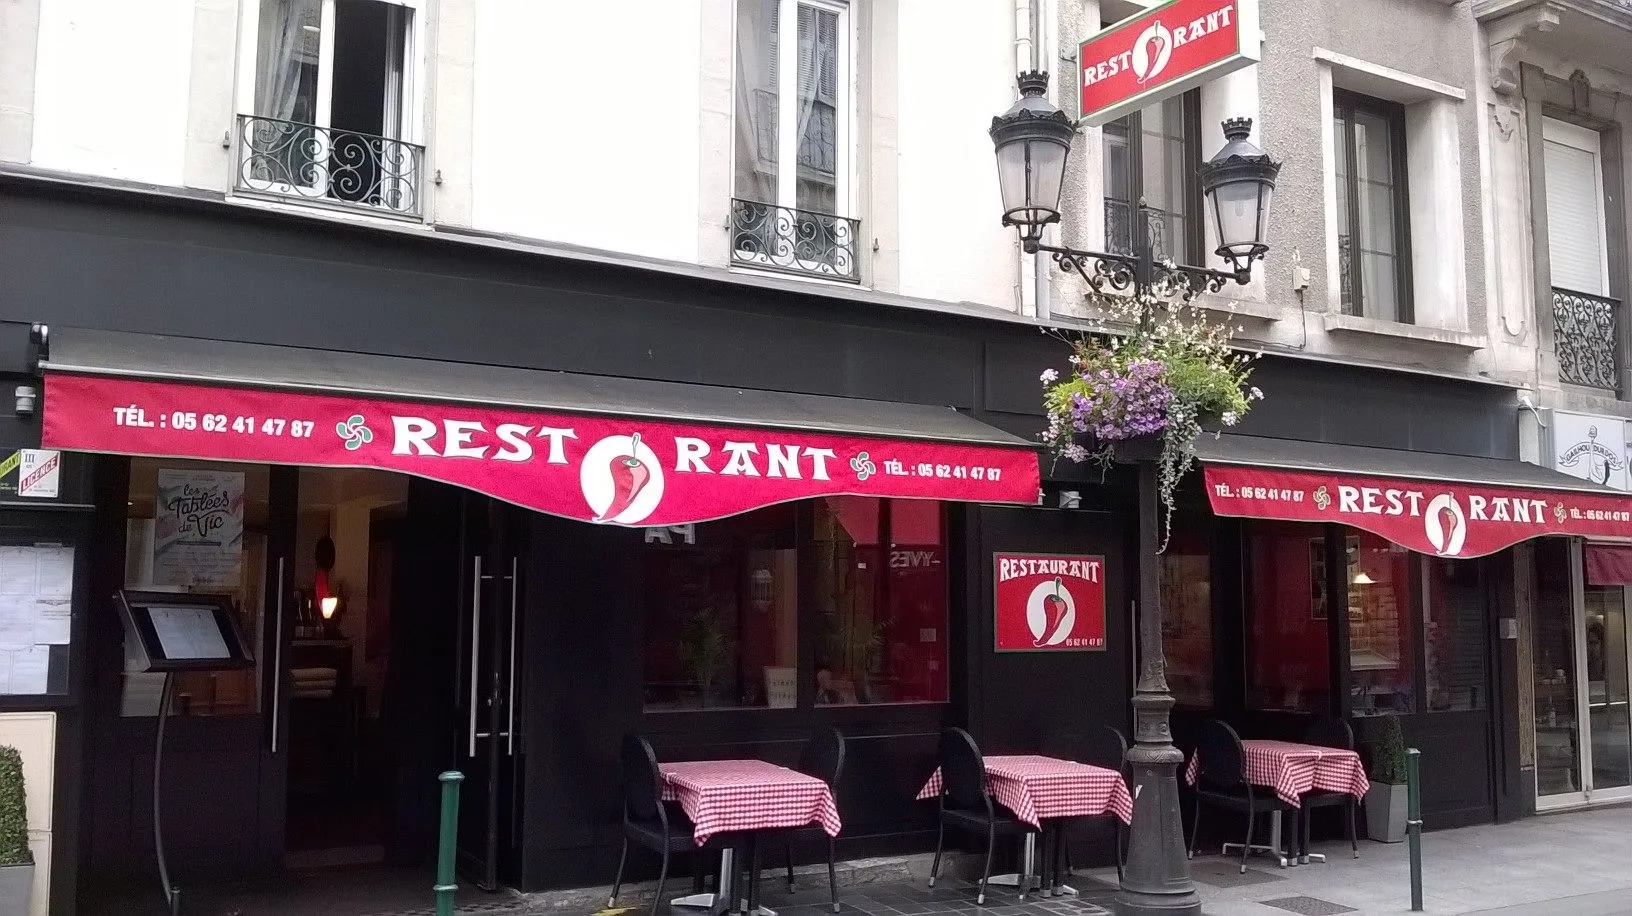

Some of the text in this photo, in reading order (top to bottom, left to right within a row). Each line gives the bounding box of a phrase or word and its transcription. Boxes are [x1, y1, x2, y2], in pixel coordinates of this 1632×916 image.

[113, 404, 154, 428] TÉL.
[172, 411, 197, 431] 05
[202, 413, 227, 433] 62
[232, 416, 255, 434] 41
[261, 418, 286, 436] 47
[291, 420, 315, 438] 87
[21, 455, 58, 492] LICENCE
[884, 458, 909, 476] TÉL.
[918, 463, 934, 477] 05
[935, 464, 951, 478] 62
[953, 465, 967, 479] 41
[970, 466, 985, 480] 47
[987, 467, 1001, 481] 87
[1241, 486, 1253, 498] 05
[1255, 487, 1267, 499] 62
[1268, 488, 1278, 500] 41
[1281, 489, 1291, 501] 47
[1293, 490, 1304, 502] 87
[999, 558, 1100, 583] RESTAURANT
